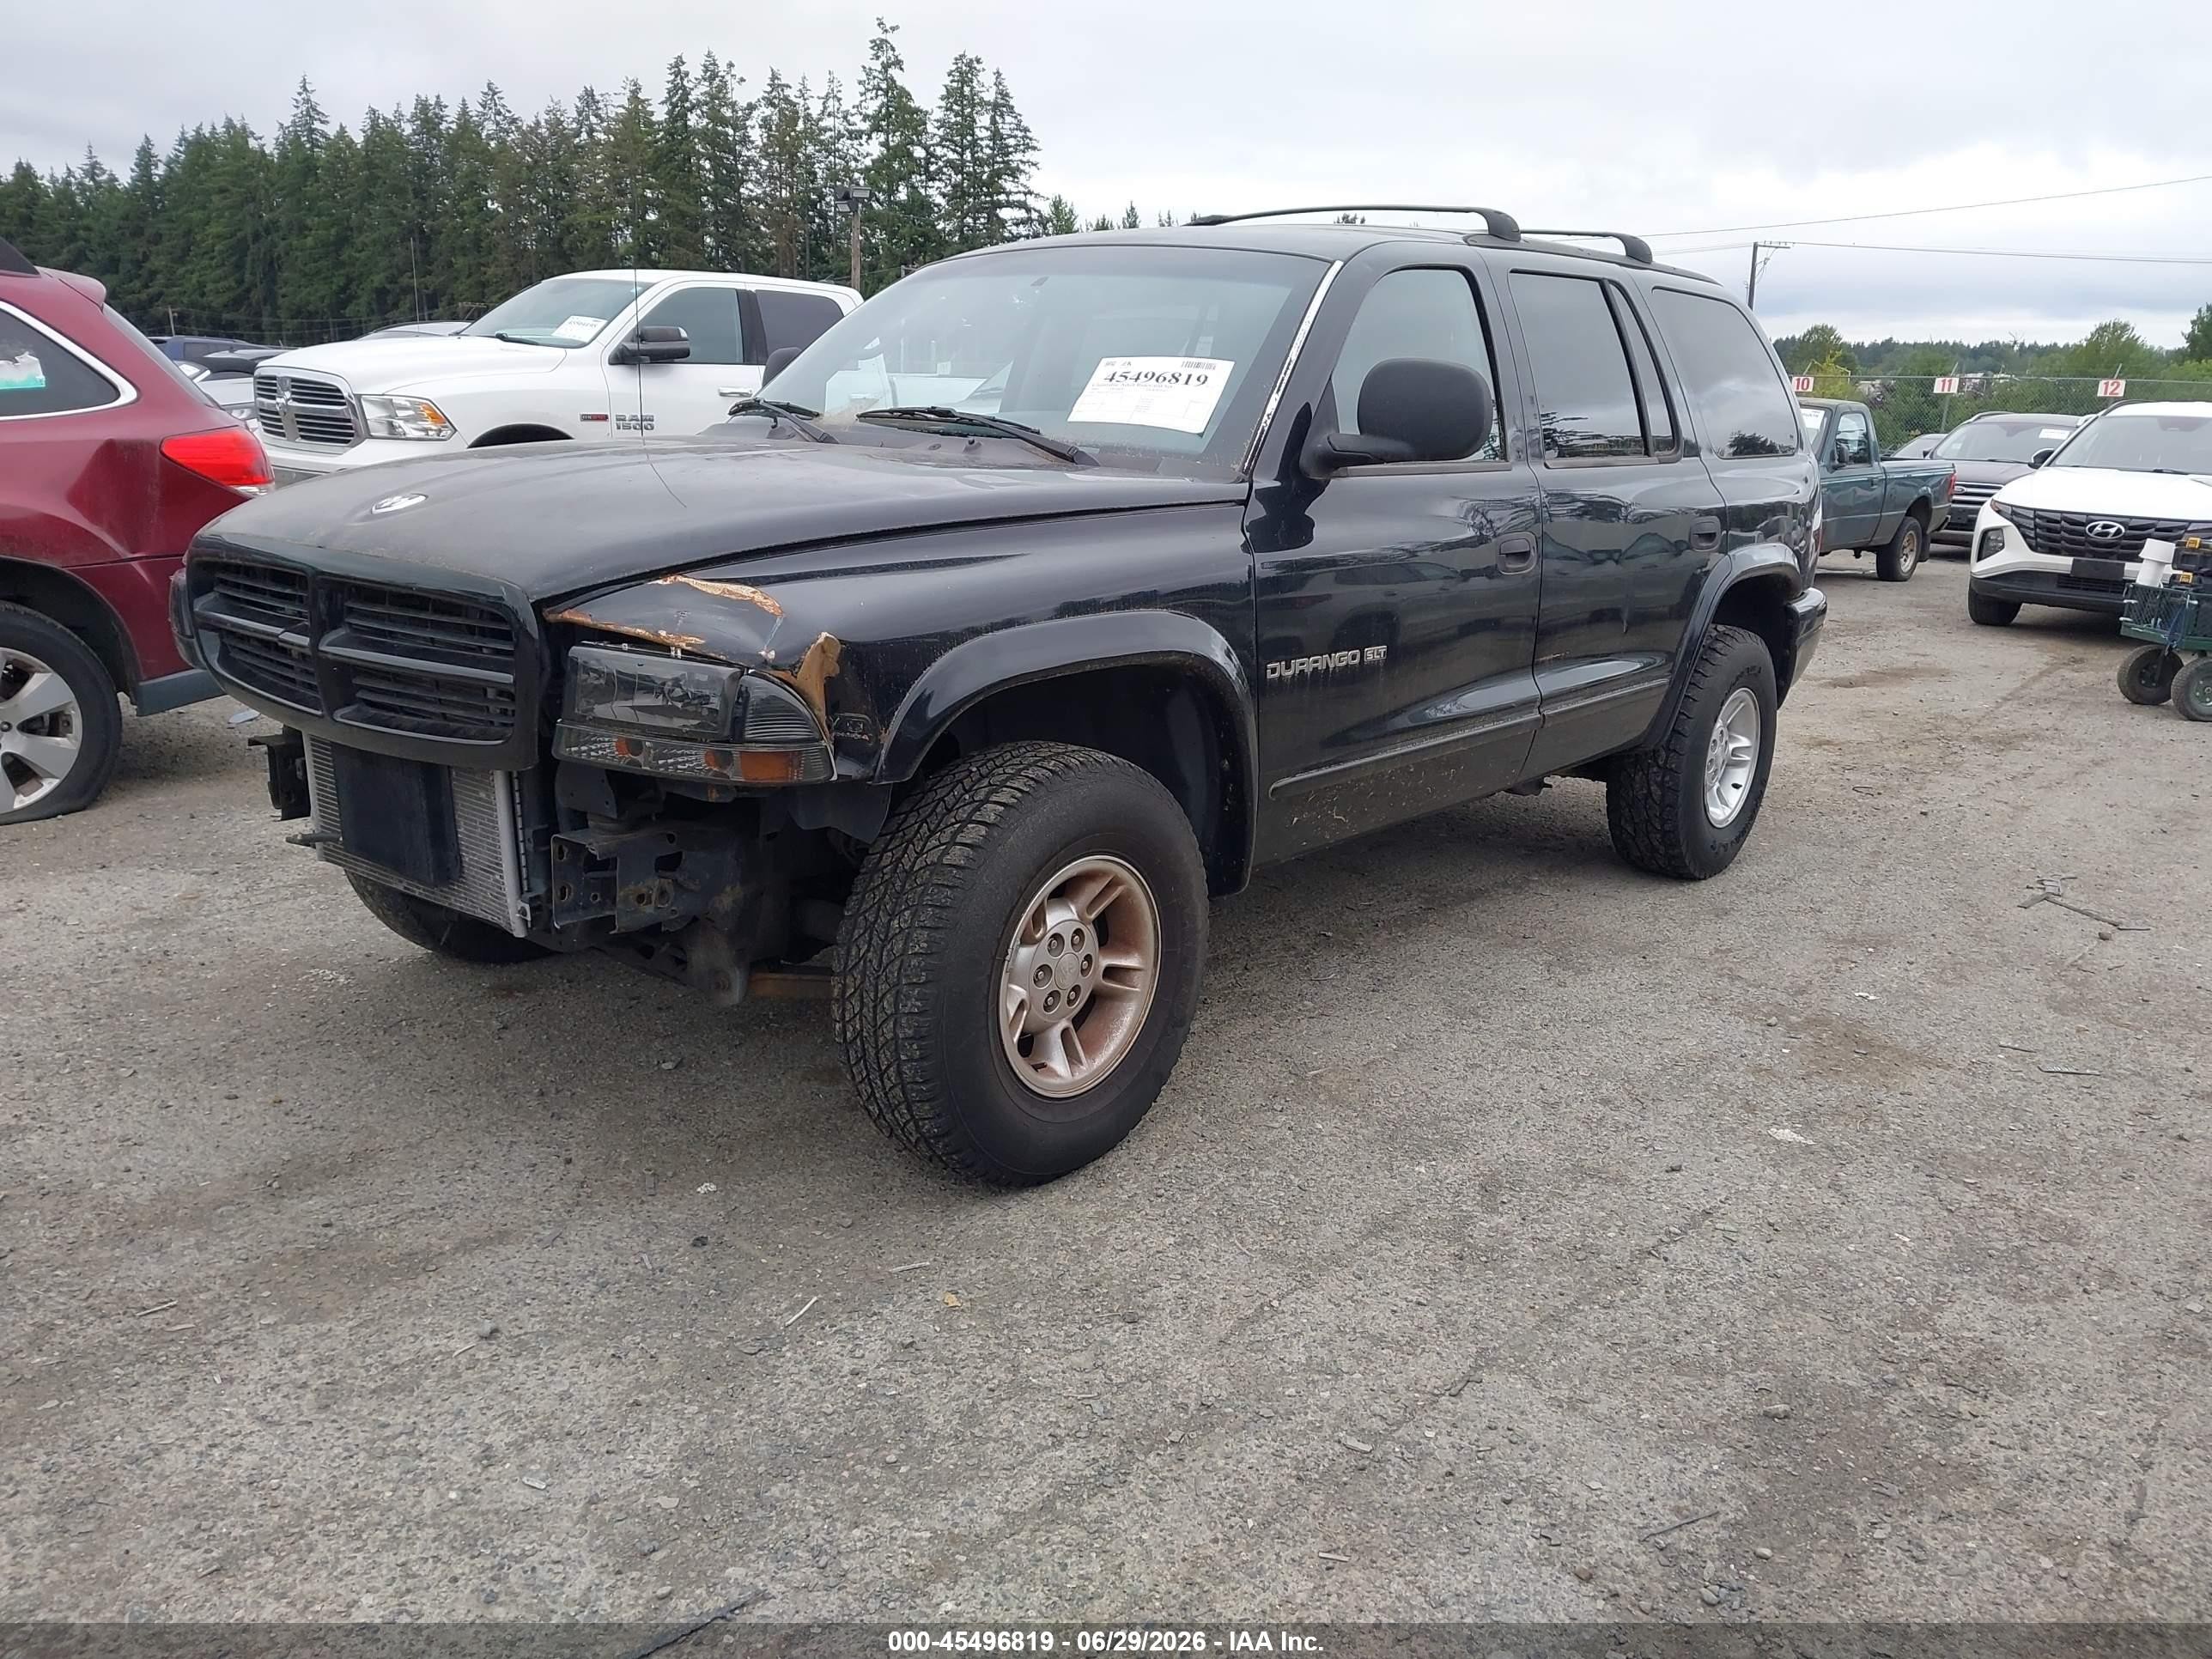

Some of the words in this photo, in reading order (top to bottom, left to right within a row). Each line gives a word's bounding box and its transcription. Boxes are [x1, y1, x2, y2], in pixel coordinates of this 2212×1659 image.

[1104, 370, 1209, 386] 45496819
[1796, 377, 1810, 391] 10
[1941, 379, 1953, 392] 11
[2104, 380, 2121, 396] 12
[616, 422, 654, 431] 1500
[1267, 649, 1361, 679] DURANGO
[1365, 647, 1387, 660] SLT
